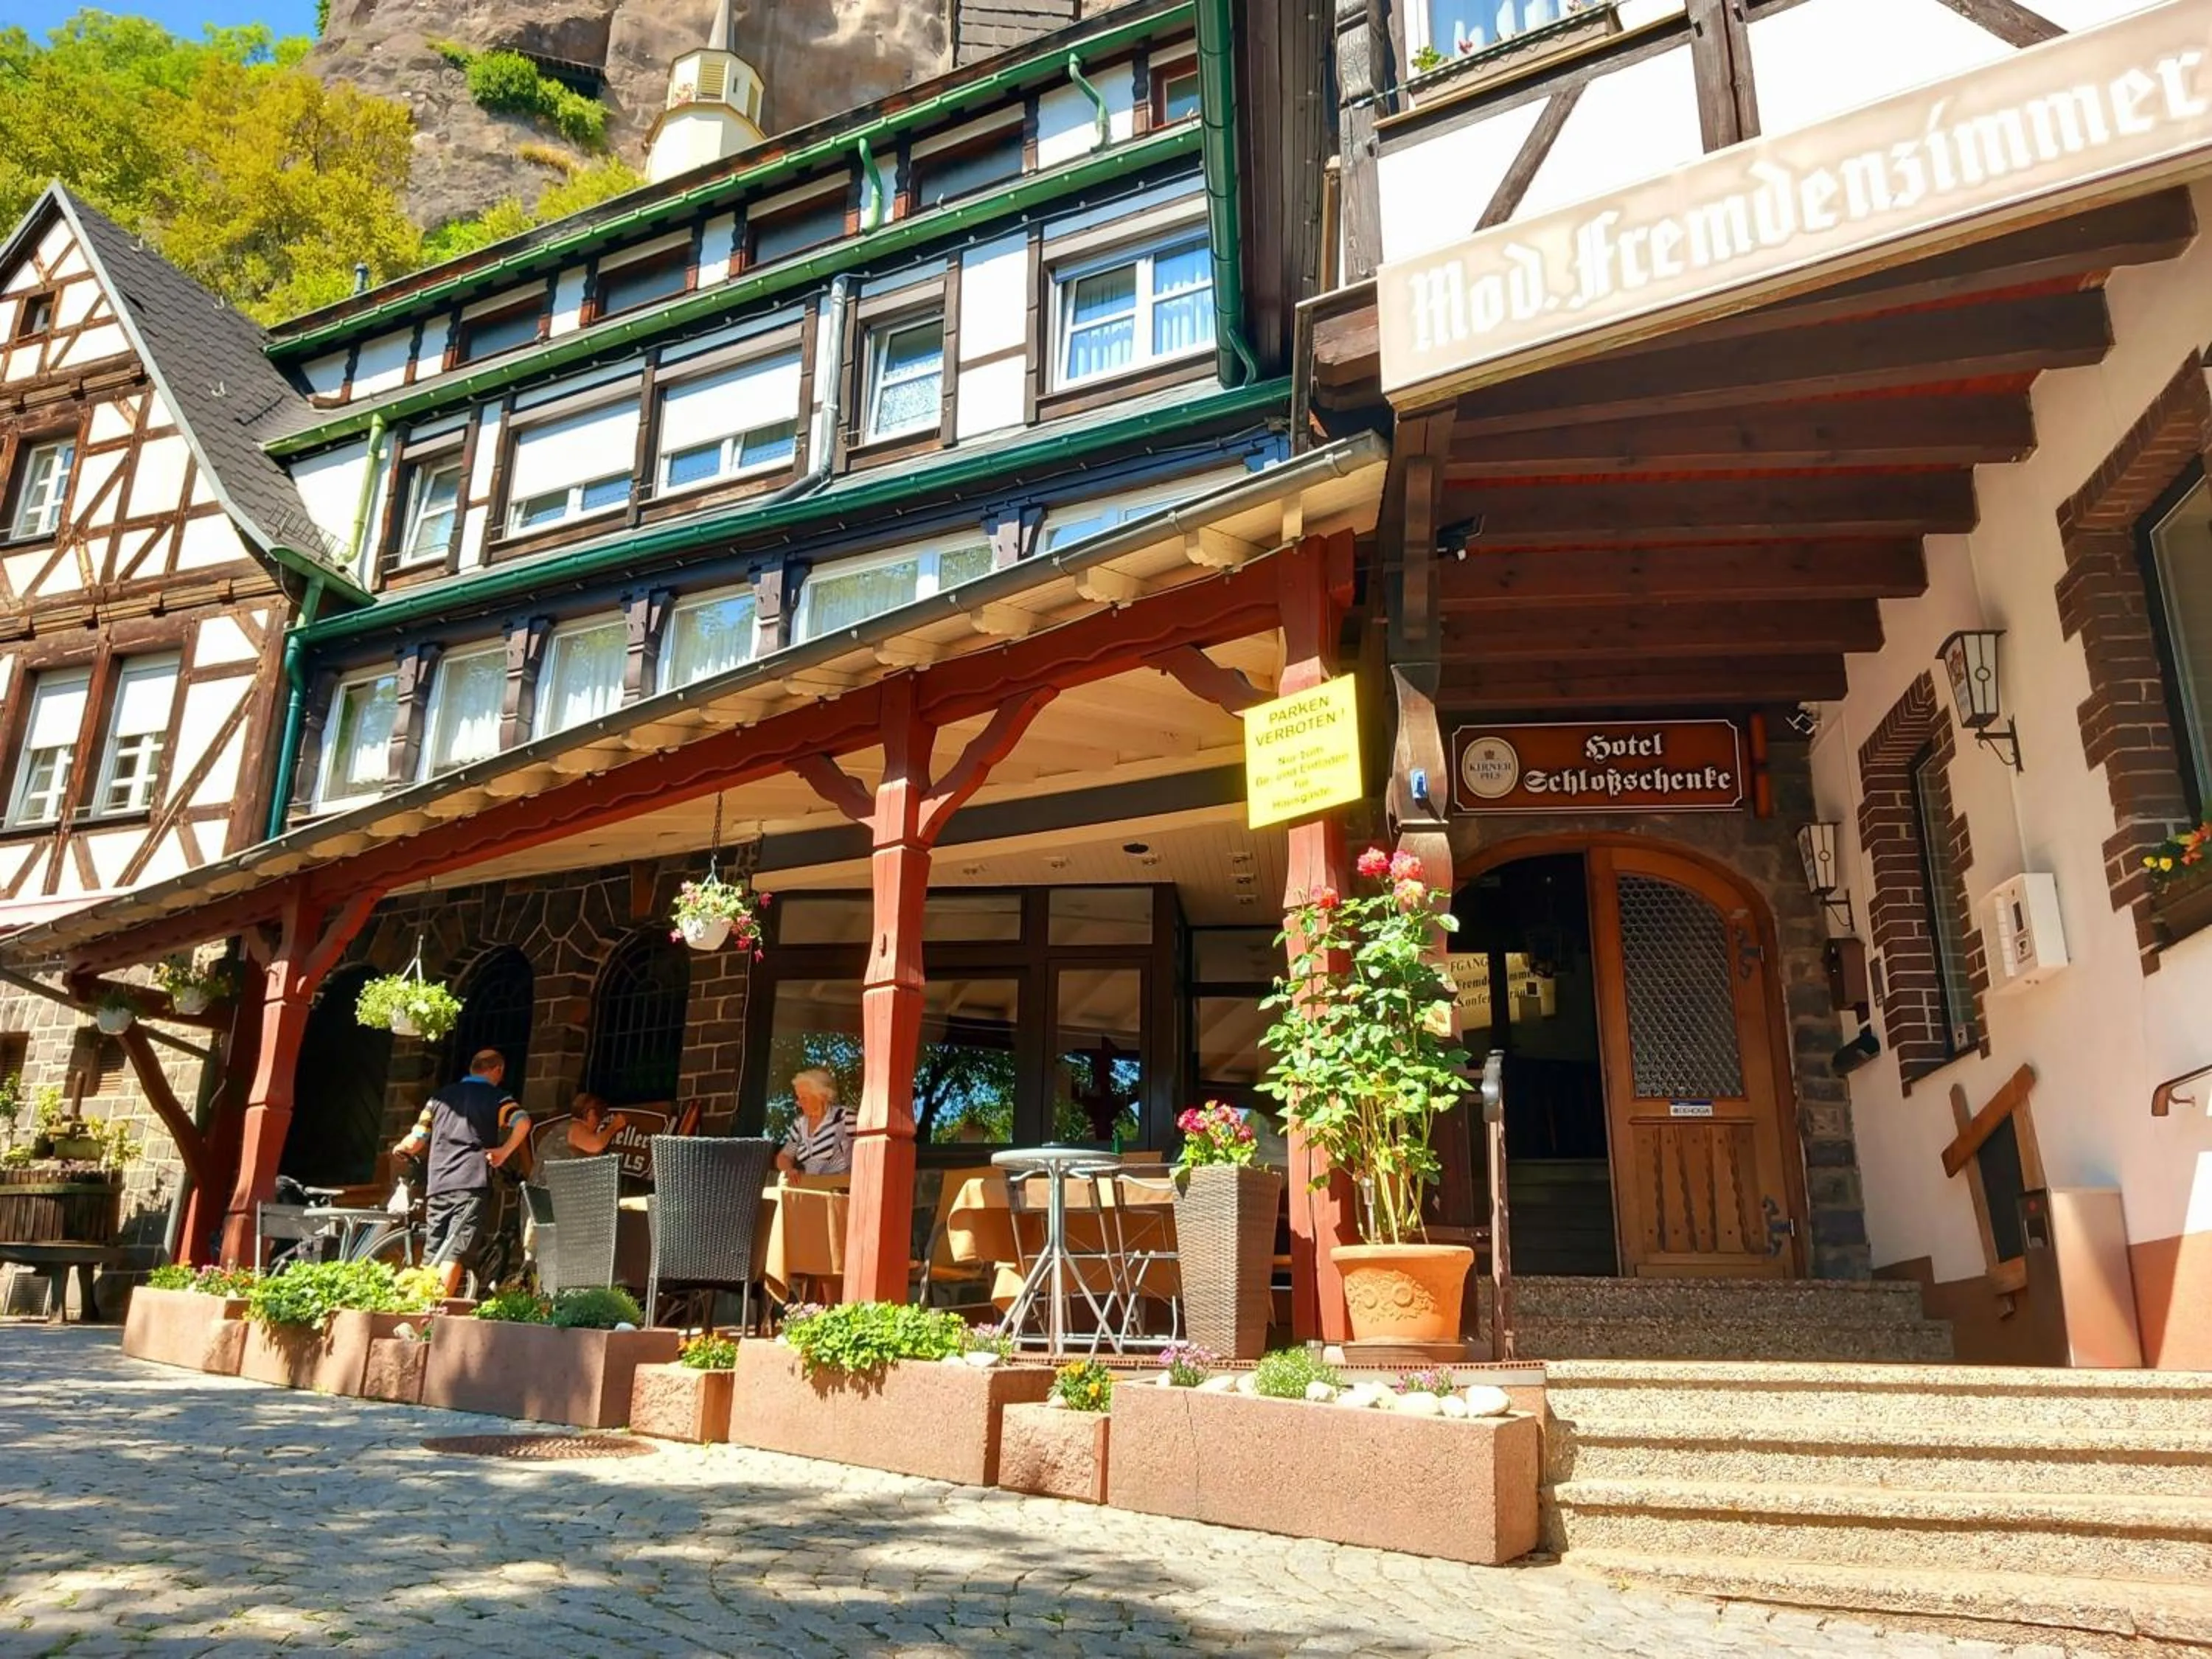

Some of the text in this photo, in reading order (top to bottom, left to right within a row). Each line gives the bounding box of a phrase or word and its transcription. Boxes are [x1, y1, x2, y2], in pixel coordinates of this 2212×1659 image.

[1408, 49, 2205, 353] Mod. Fremdenzimmer
[1269, 695, 1329, 724] PARKEN
[1585, 732, 1663, 764] Hotel
[1523, 767, 1731, 797] Schloßschenke
